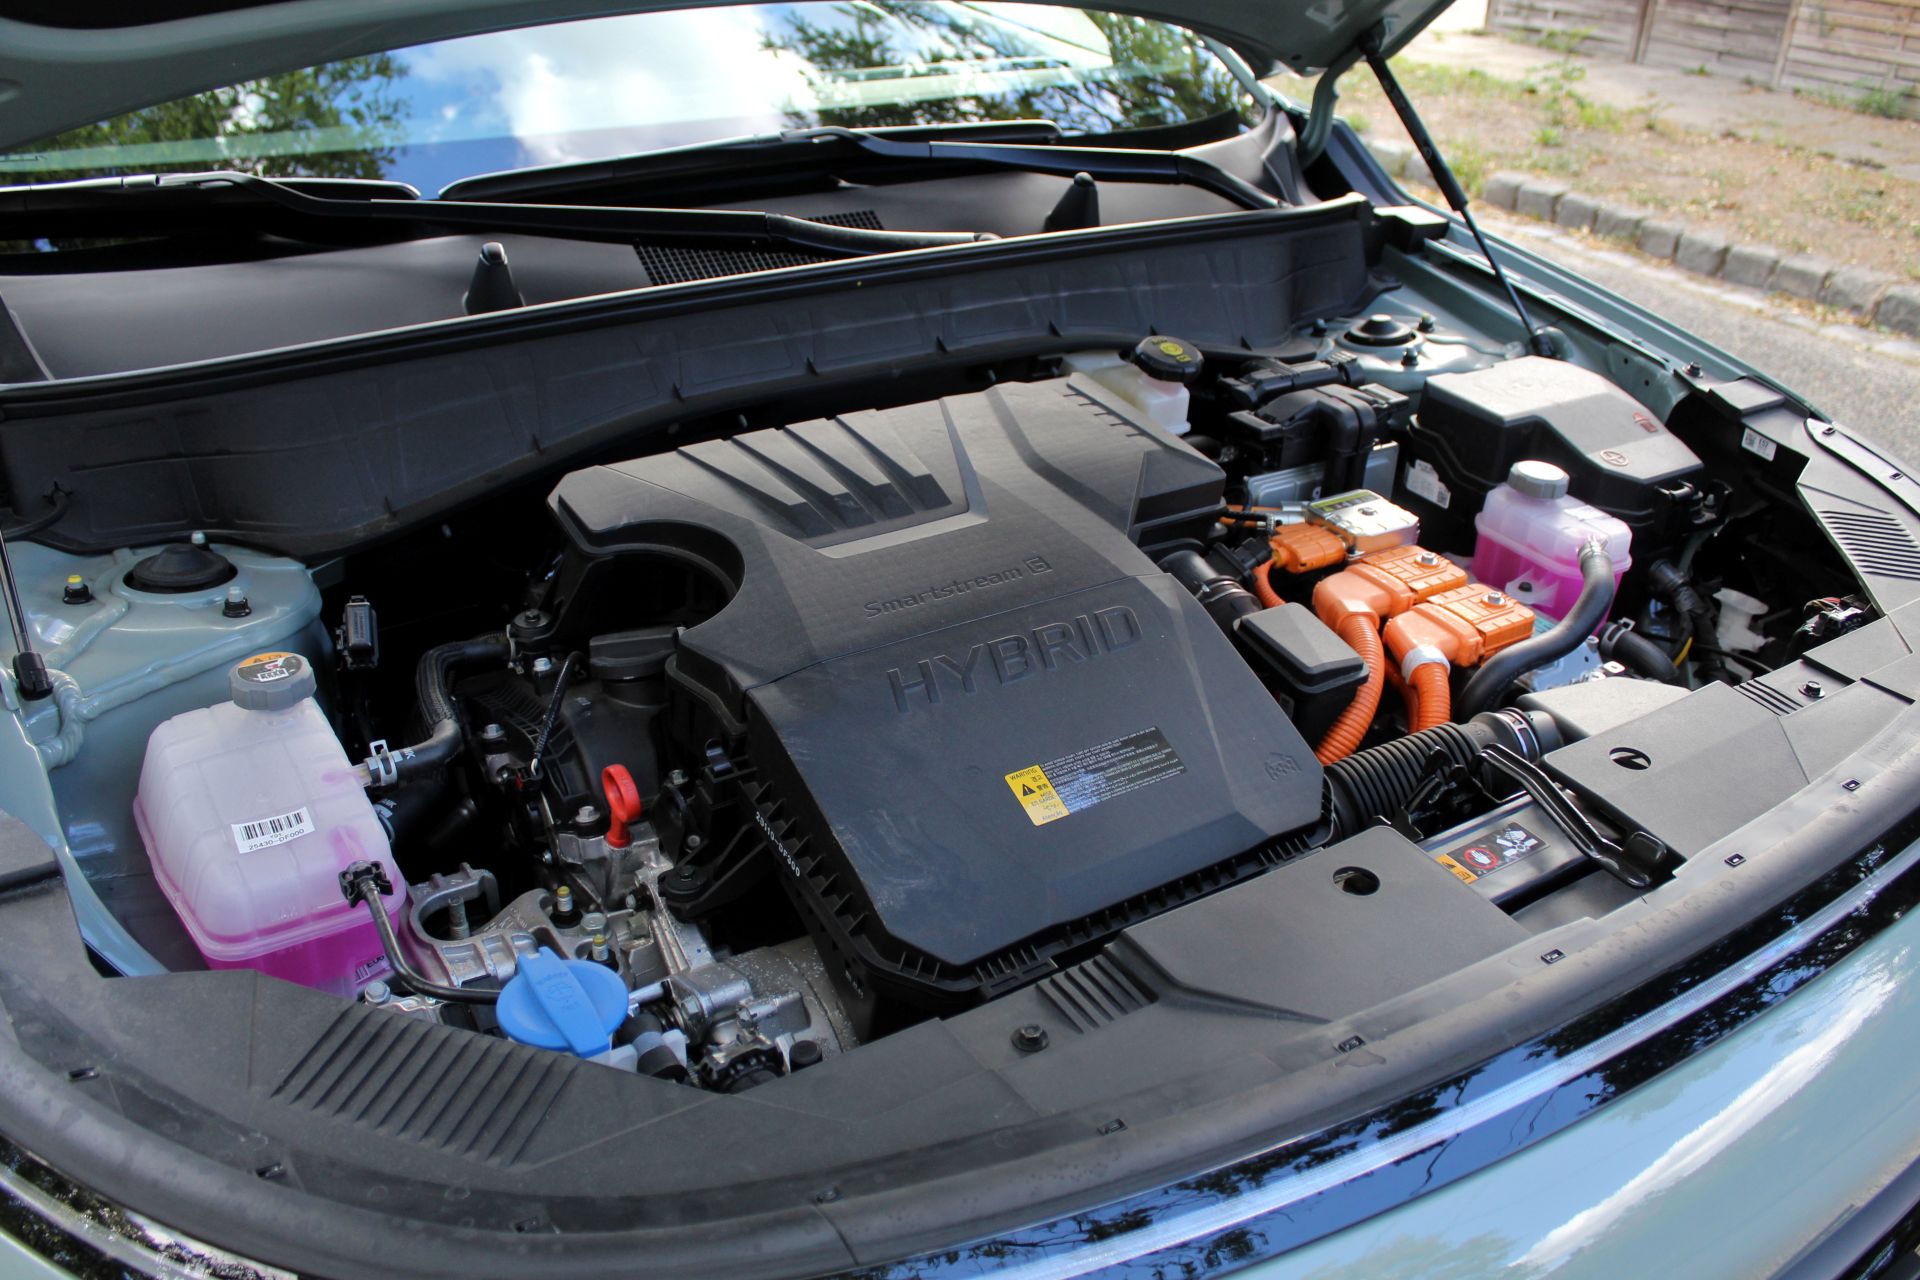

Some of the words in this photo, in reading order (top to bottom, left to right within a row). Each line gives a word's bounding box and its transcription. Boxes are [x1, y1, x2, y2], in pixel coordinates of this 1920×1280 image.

[863, 567, 1023, 619] Smartstream
[886, 604, 1144, 713] HYBRID
[1009, 767, 1038, 780] WARNING
[248, 828, 305, 851] 25430-DF000
